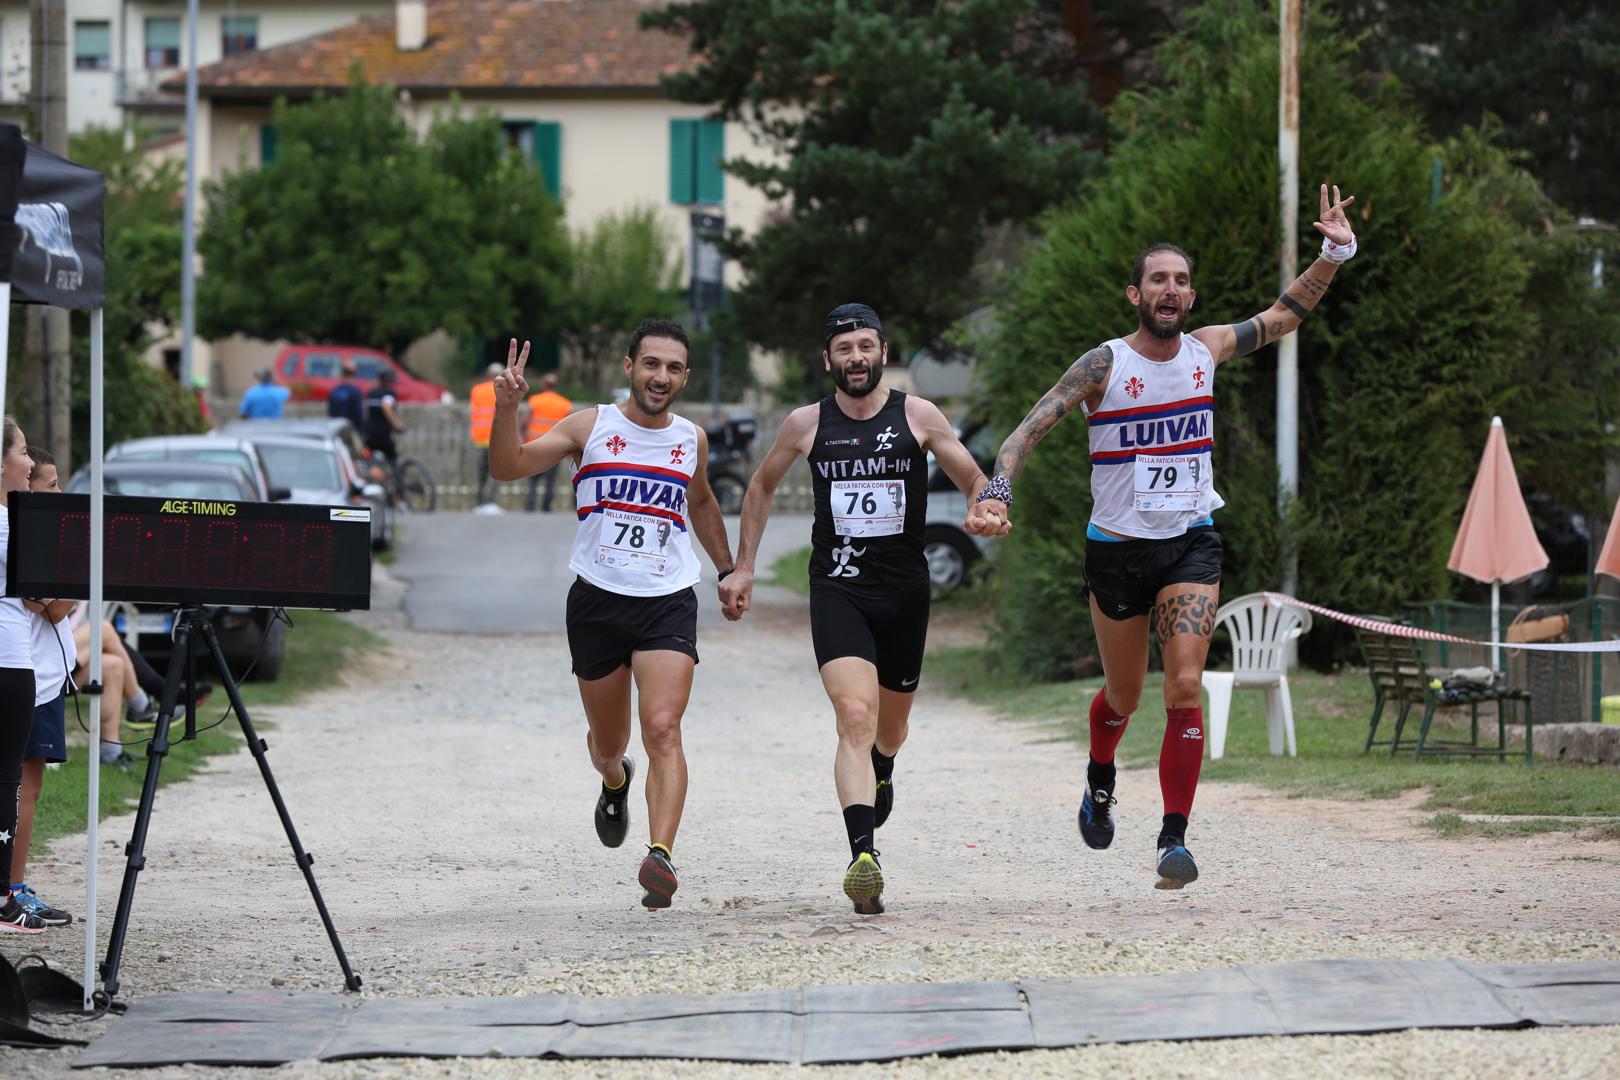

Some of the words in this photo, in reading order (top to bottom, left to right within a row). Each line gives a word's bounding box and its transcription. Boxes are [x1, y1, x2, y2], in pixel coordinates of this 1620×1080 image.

[1120, 412, 1208, 448] LUIVAN
[817, 457, 910, 478] VITAM-IN
[1147, 466, 1178, 490] 79
[595, 478, 685, 512] LUIVAN
[844, 491, 877, 515] 76
[160, 500, 236, 516] ALGE-TIMING
[606, 511, 622, 519] NELLA
[624, 514, 642, 522] FATICA
[614, 522, 645, 548] 78
